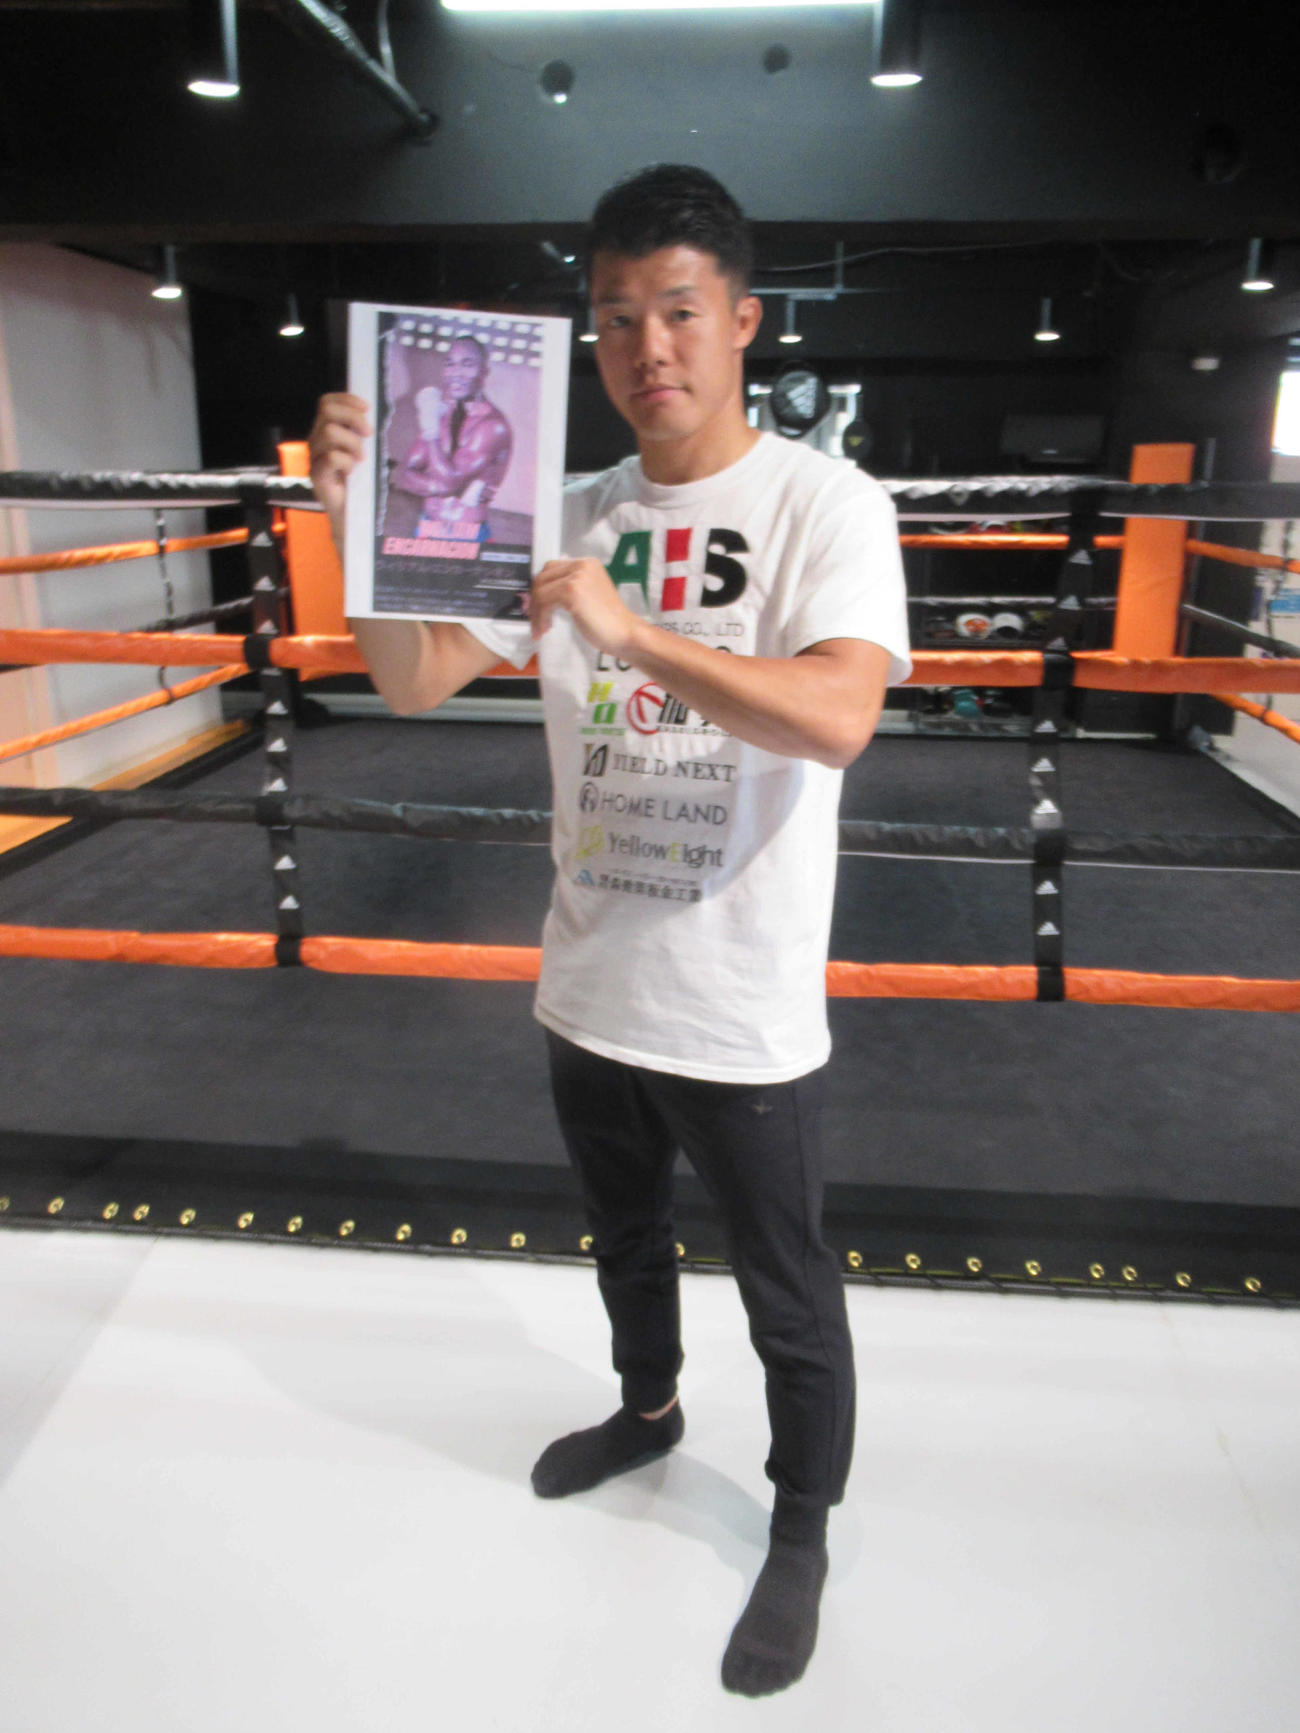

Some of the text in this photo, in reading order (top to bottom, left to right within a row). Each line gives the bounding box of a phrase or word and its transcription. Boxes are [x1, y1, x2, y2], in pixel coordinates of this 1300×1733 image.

[674, 760, 737, 782] NEXT
[602, 790, 728, 826] HOME LAND
[608, 831, 724, 868] YellowEight
